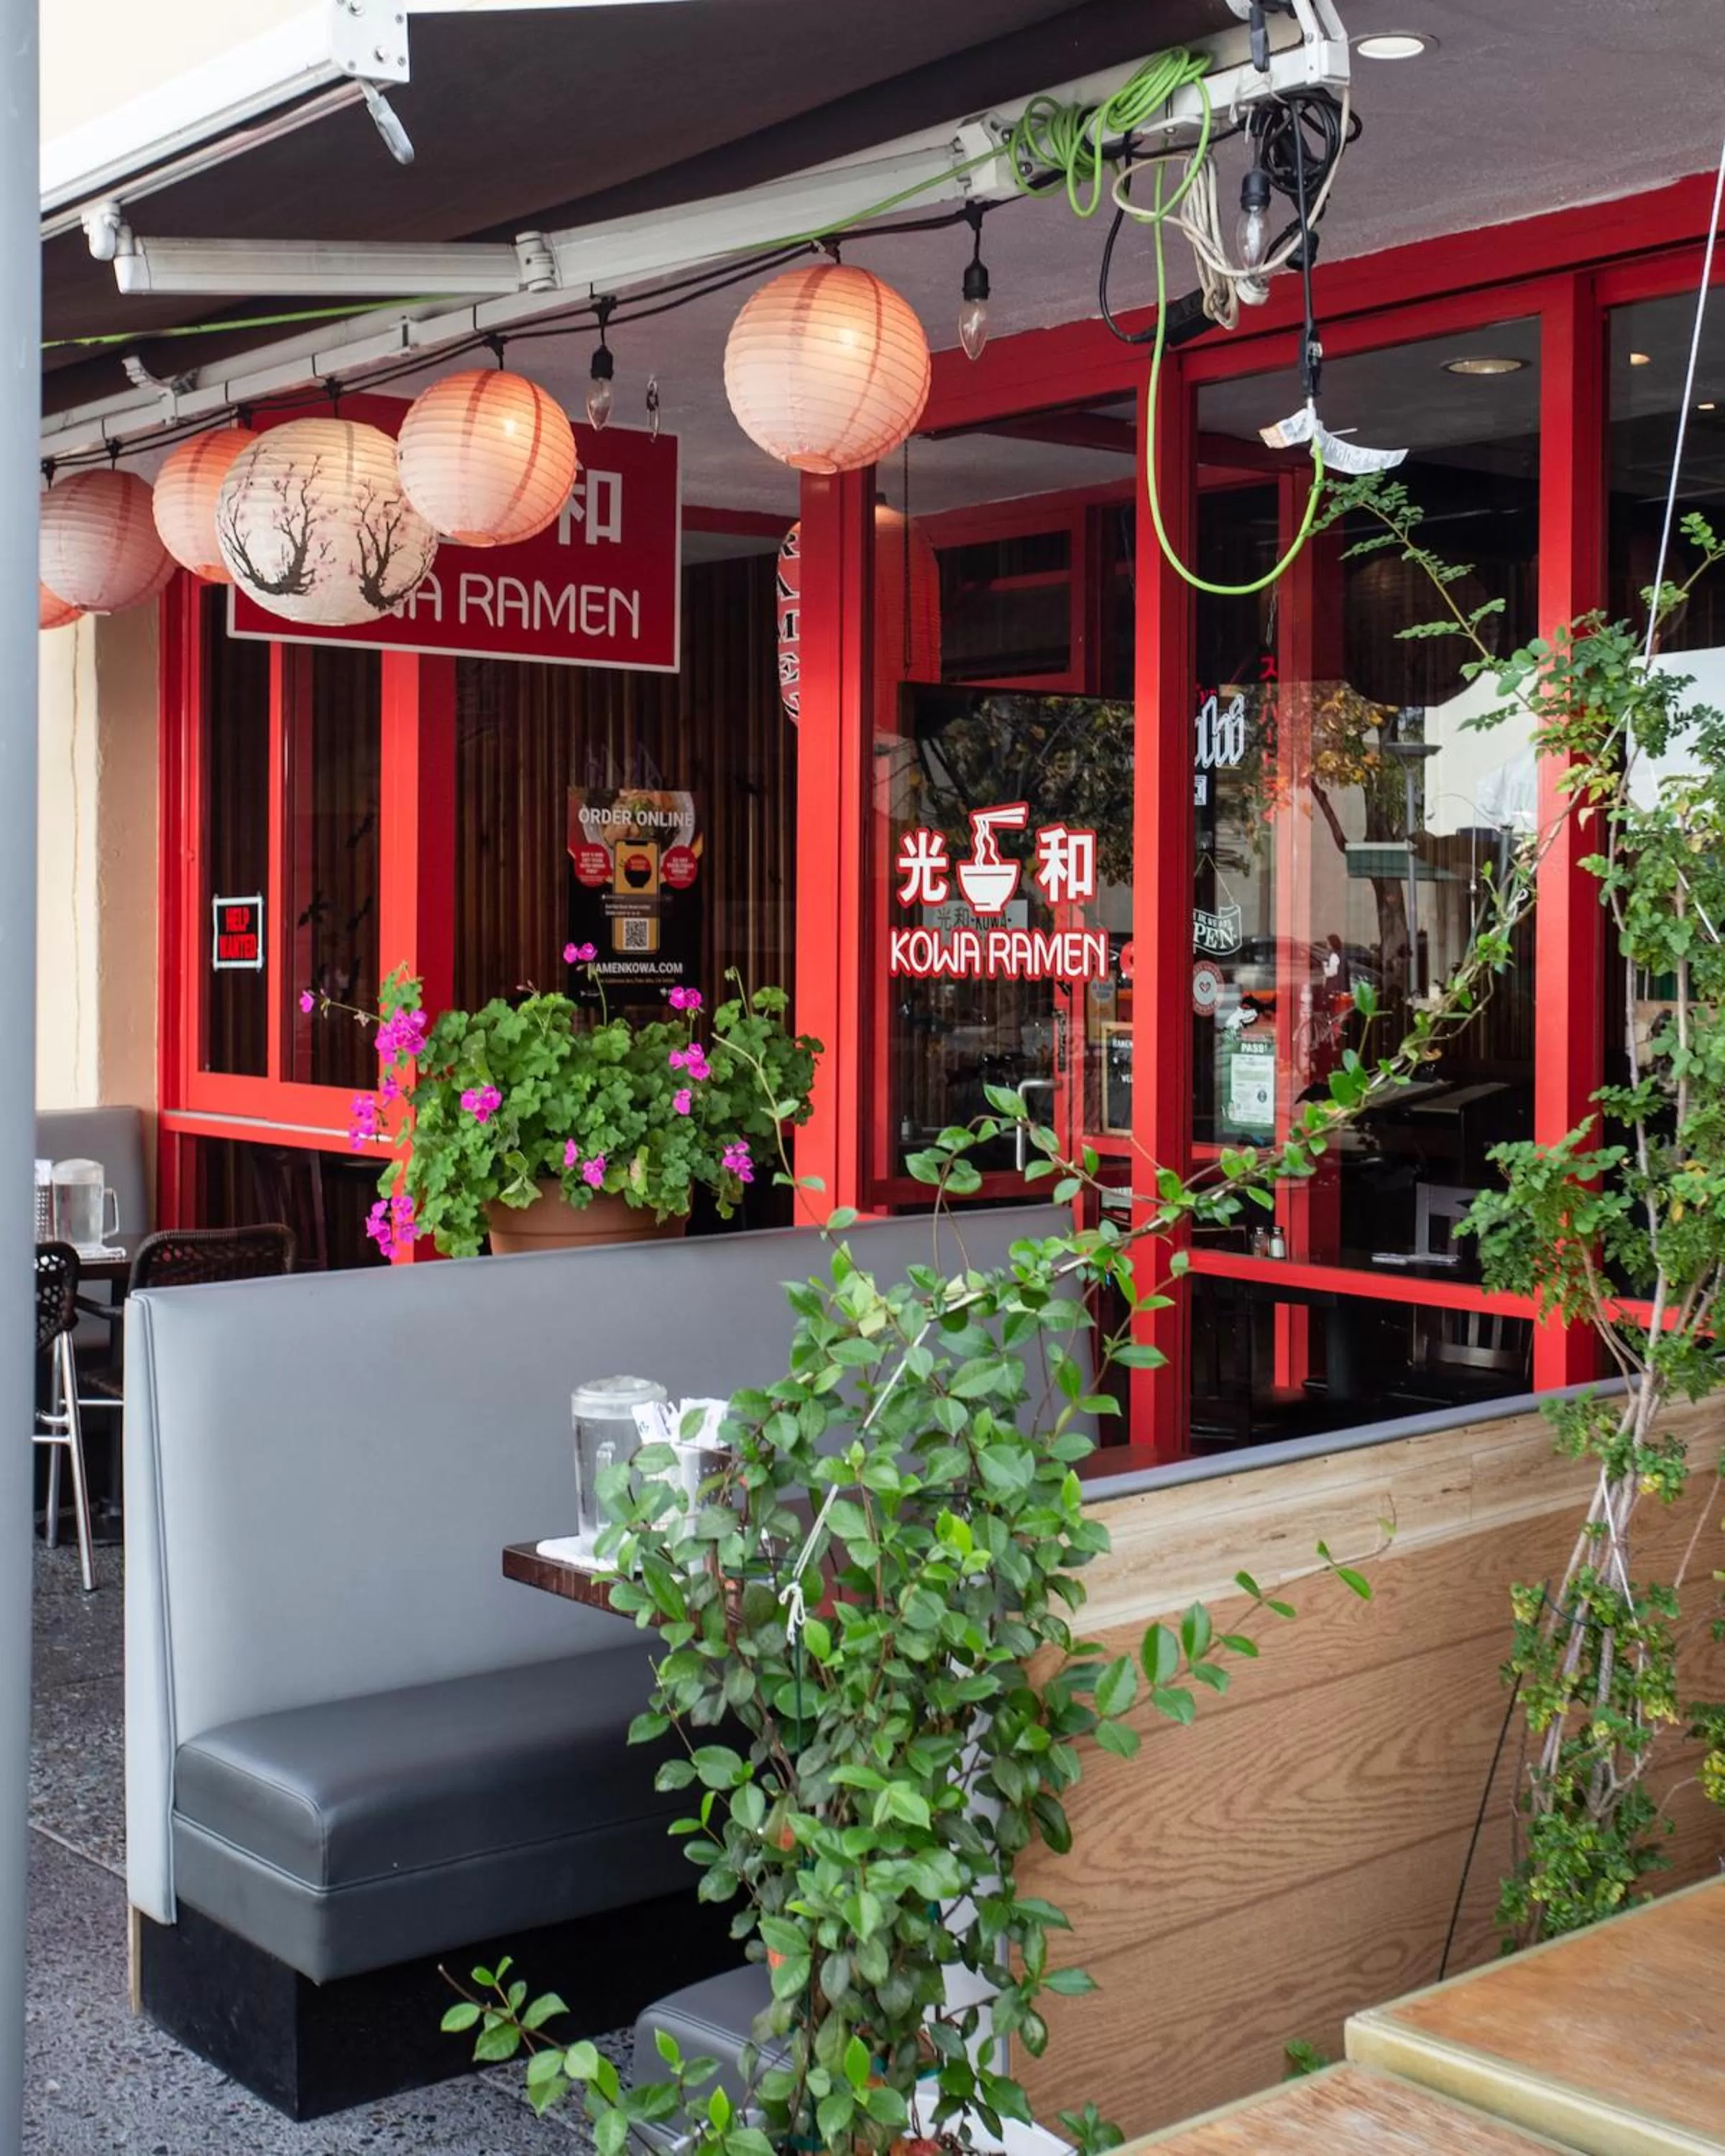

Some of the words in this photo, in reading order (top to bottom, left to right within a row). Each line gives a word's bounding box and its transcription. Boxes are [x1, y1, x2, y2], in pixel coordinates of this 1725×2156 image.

[459, 573, 640, 640] RAMEN
[578, 807, 632, 826] ORDER
[637, 811, 693, 827] ONLINE
[898, 831, 947, 902] 光
[1039, 827, 1094, 903] 和
[891, 930, 980, 974] KOWA
[988, 931, 1106, 977] RAMEN
[1193, 922, 1235, 949] PEN
